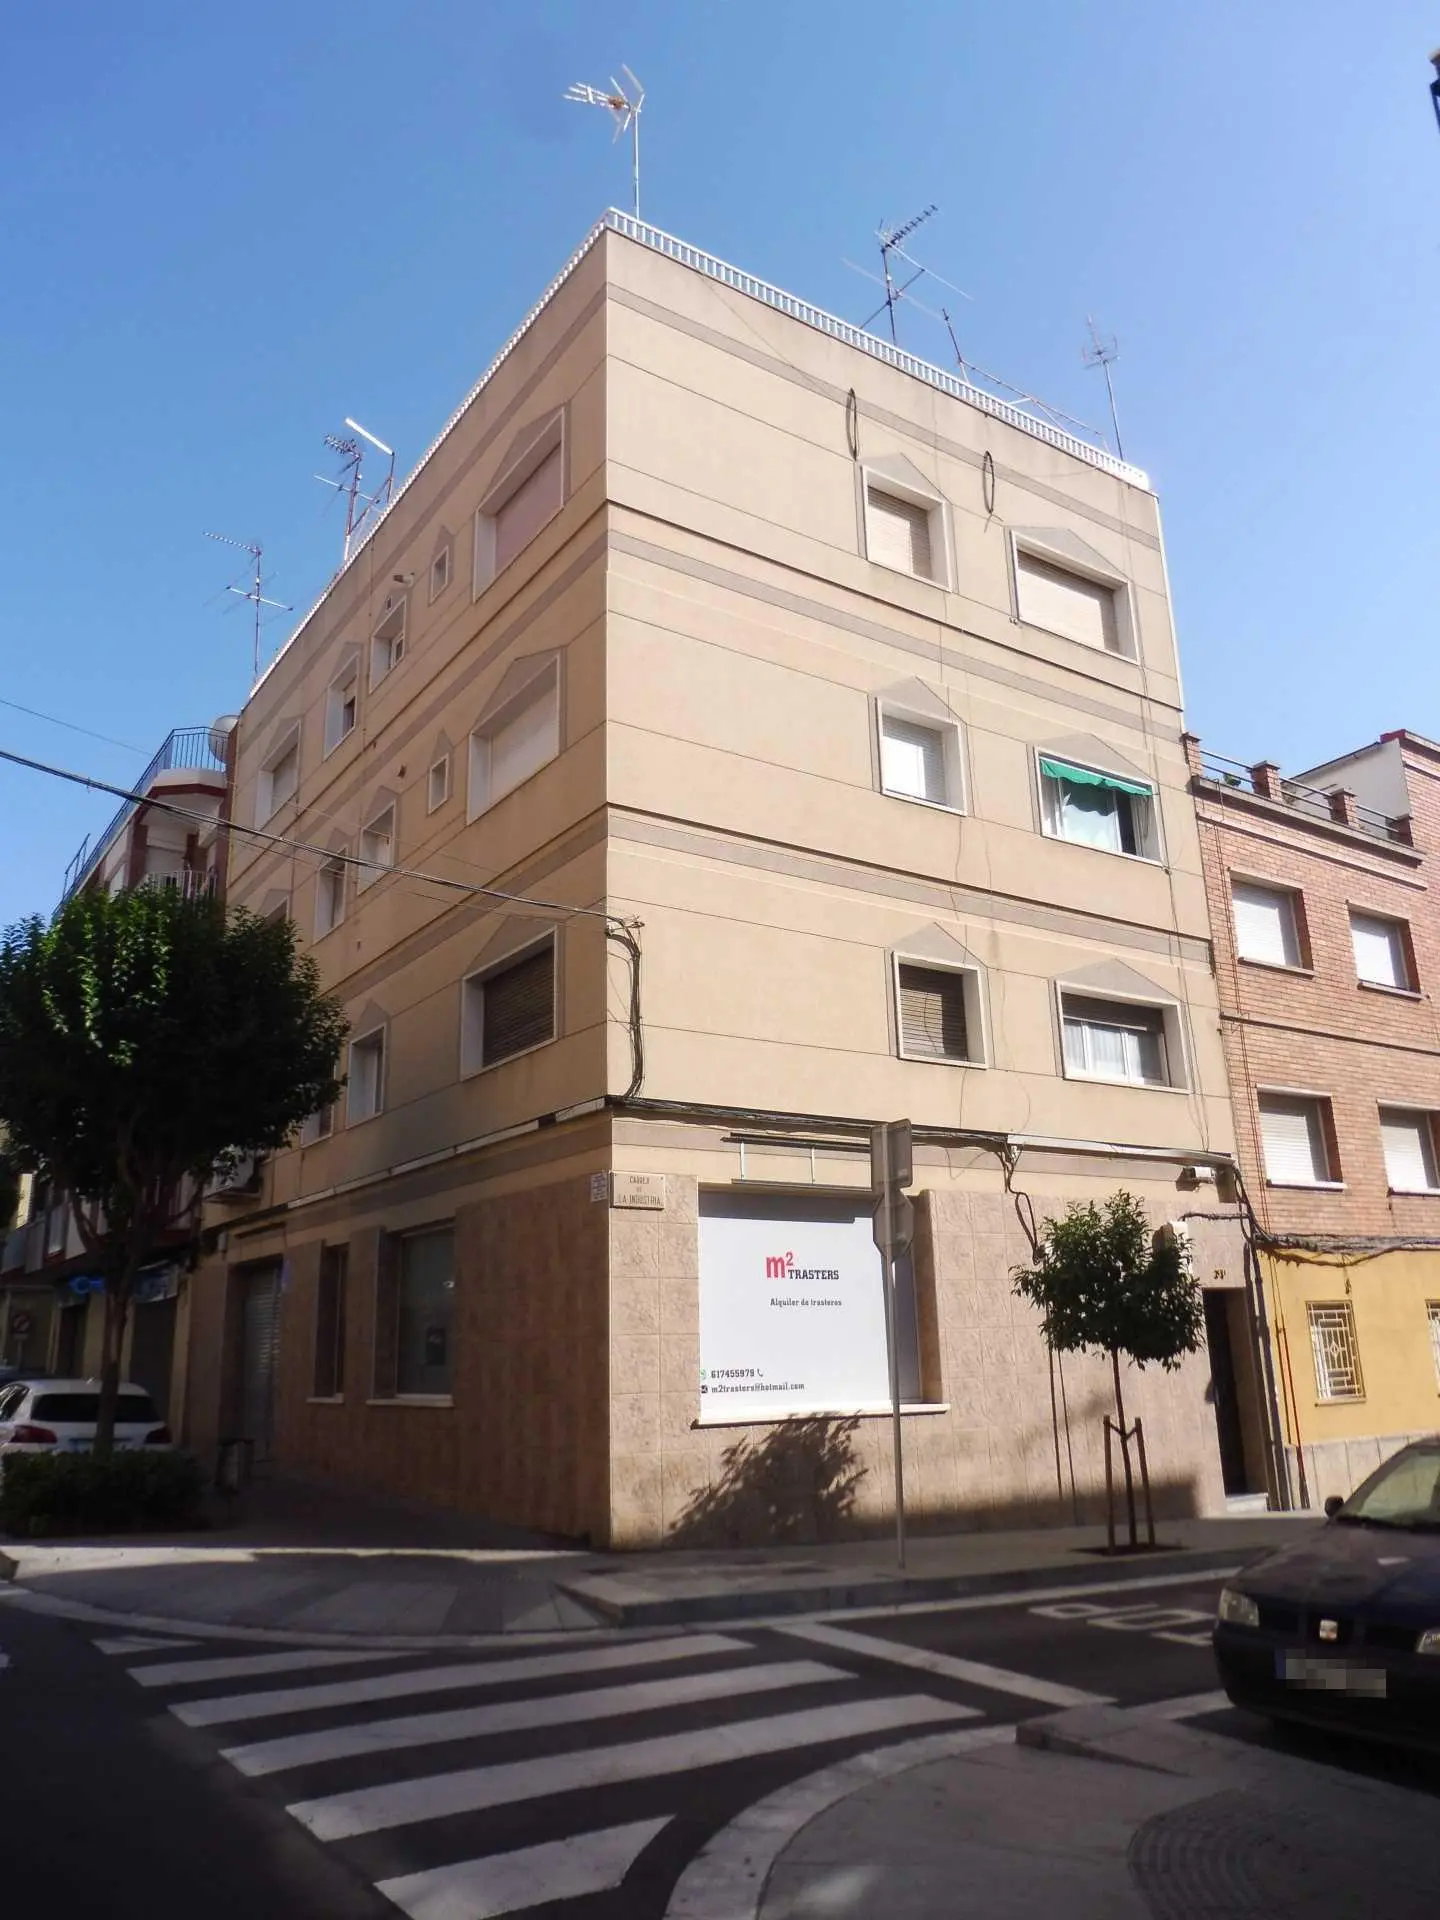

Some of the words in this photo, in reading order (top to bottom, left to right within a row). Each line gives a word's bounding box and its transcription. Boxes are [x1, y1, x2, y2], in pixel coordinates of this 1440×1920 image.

[788, 1269, 839, 1280] TRASTERS
[770, 1298, 799, 1308] Alquiler
[801, 1298, 809, 1306] de
[810, 1298, 842, 1306] trasteros
